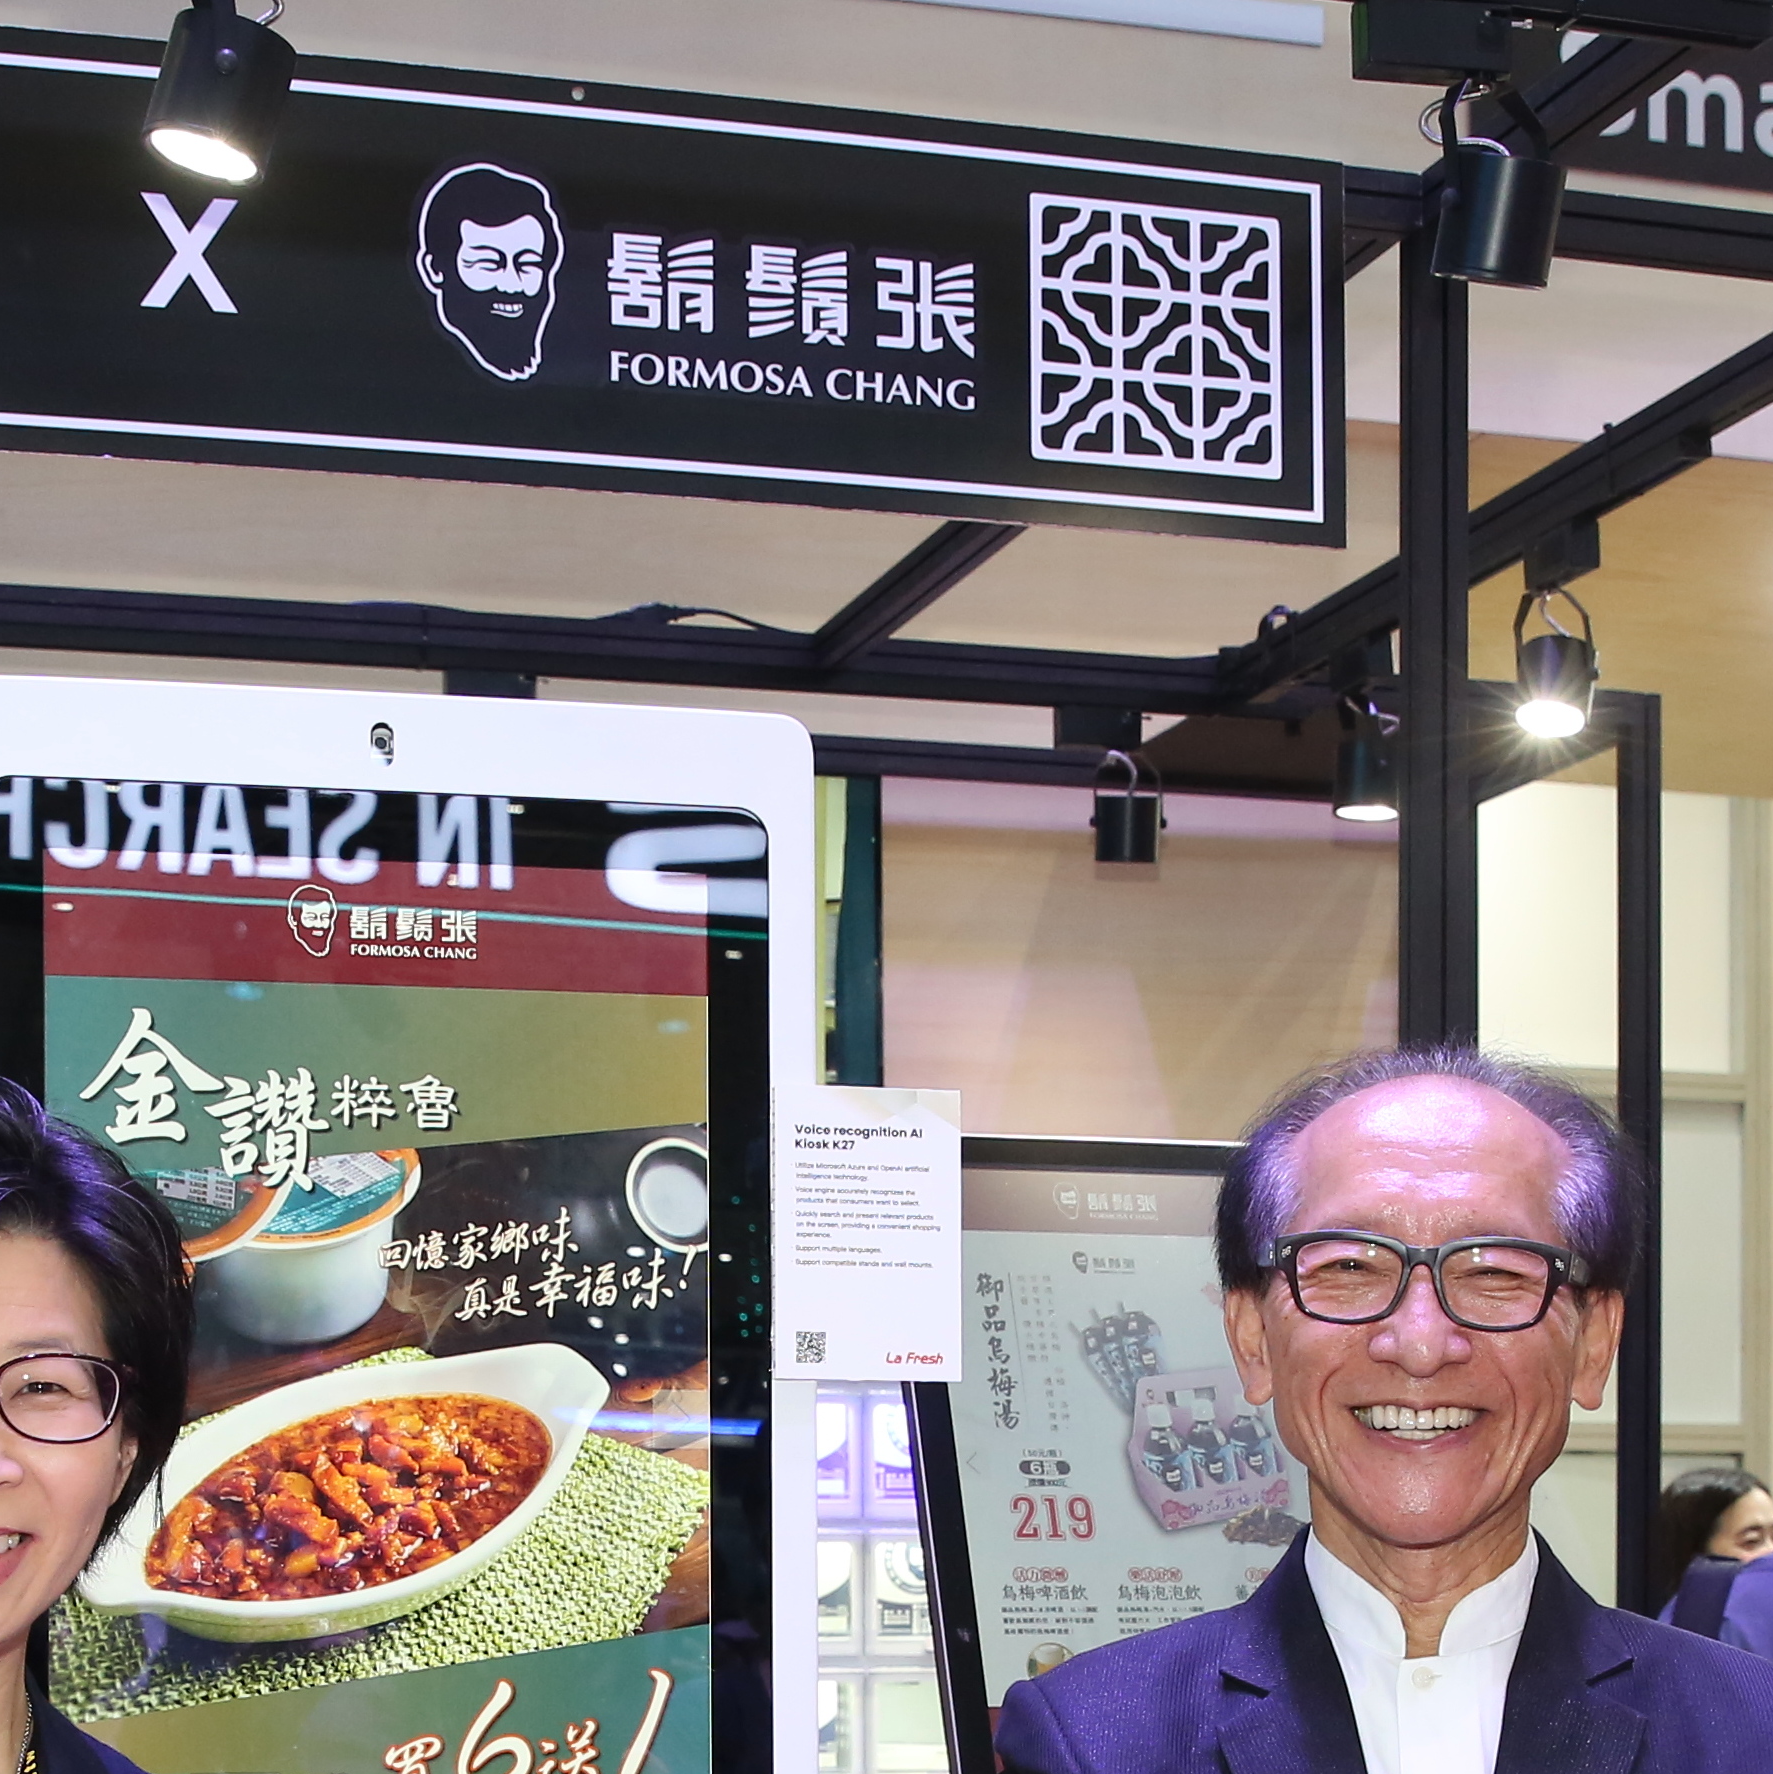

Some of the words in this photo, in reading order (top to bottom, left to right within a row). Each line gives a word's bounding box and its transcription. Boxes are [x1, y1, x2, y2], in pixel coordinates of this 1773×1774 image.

[140, 192, 238, 313] X
[607, 231, 975, 359] 鬍鬚張
[610, 350, 814, 398] FORMOSA
[826, 368, 976, 411] CHANG
[349, 905, 477, 943] 鬍鬚張
[350, 943, 420, 959] FORMOSA
[423, 944, 477, 960] CHANG
[332, 1073, 462, 1133] 粹魯
[795, 1124, 830, 1135] Voice
[834, 1125, 907, 1139] recognition
[795, 1139, 829, 1149] Kiosk
[833, 1140, 855, 1150] K27
[378, 1206, 580, 1272] 回憶家鄉味
[822, 1259, 857, 1267] compatible
[885, 1352, 903, 1364] La
[906, 1352, 943, 1365] Fresh
[1010, 1493, 1096, 1540] 219
